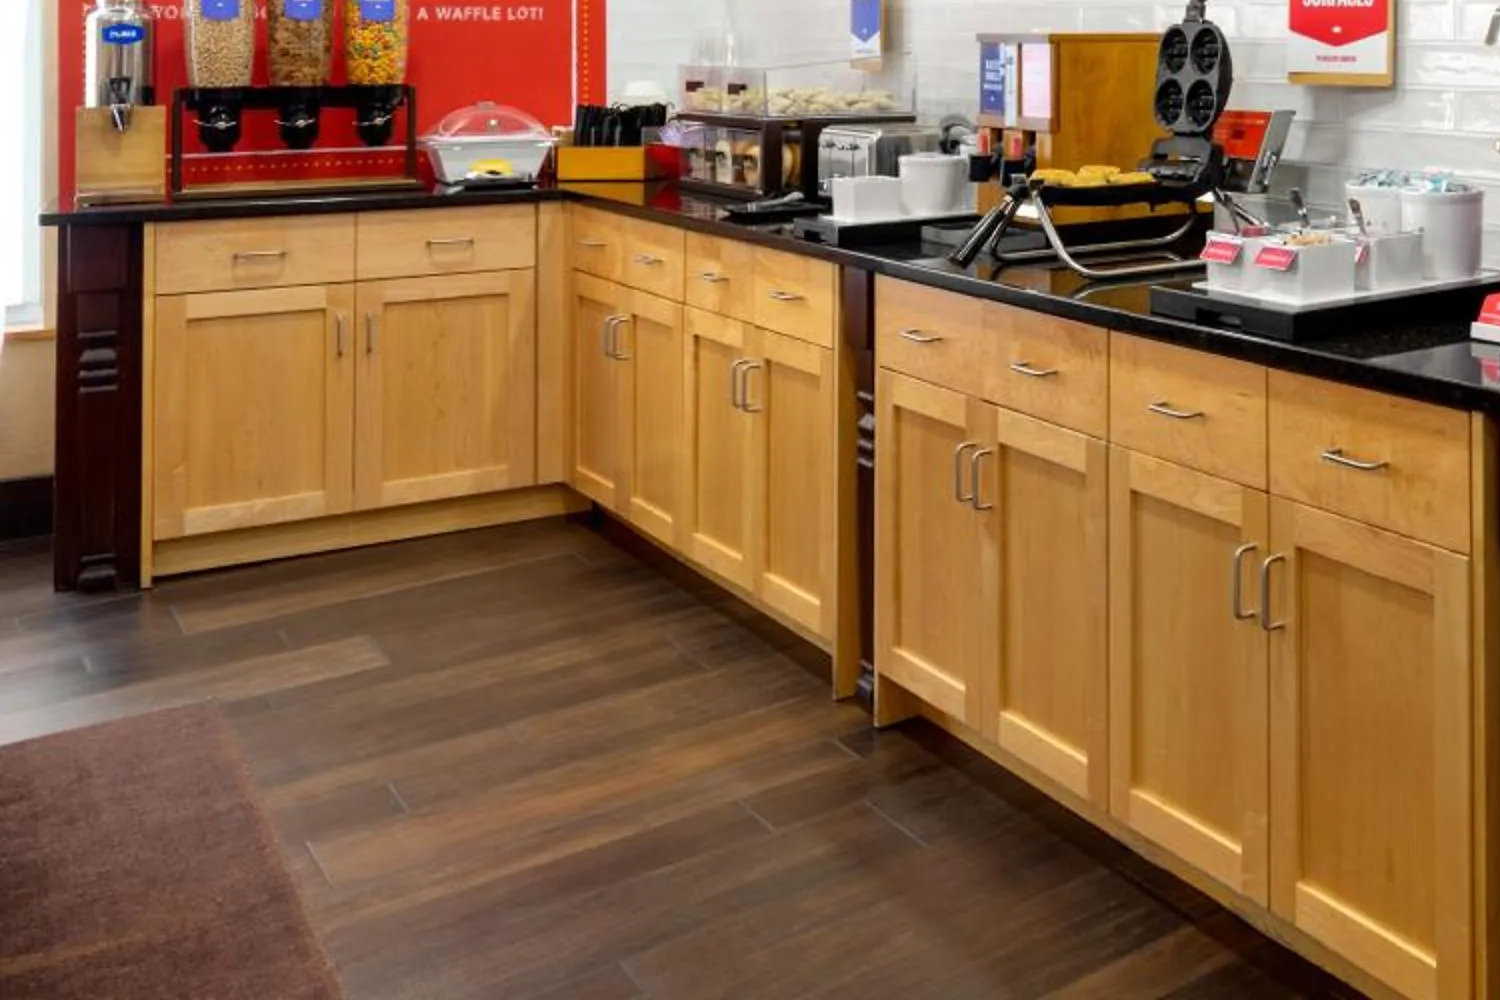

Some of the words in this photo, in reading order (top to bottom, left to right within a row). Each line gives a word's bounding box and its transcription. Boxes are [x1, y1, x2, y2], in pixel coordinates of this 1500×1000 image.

[417, 7, 428, 21] A
[436, 6, 501, 21] WAFFLE
[507, 6, 544, 21] LOT!
